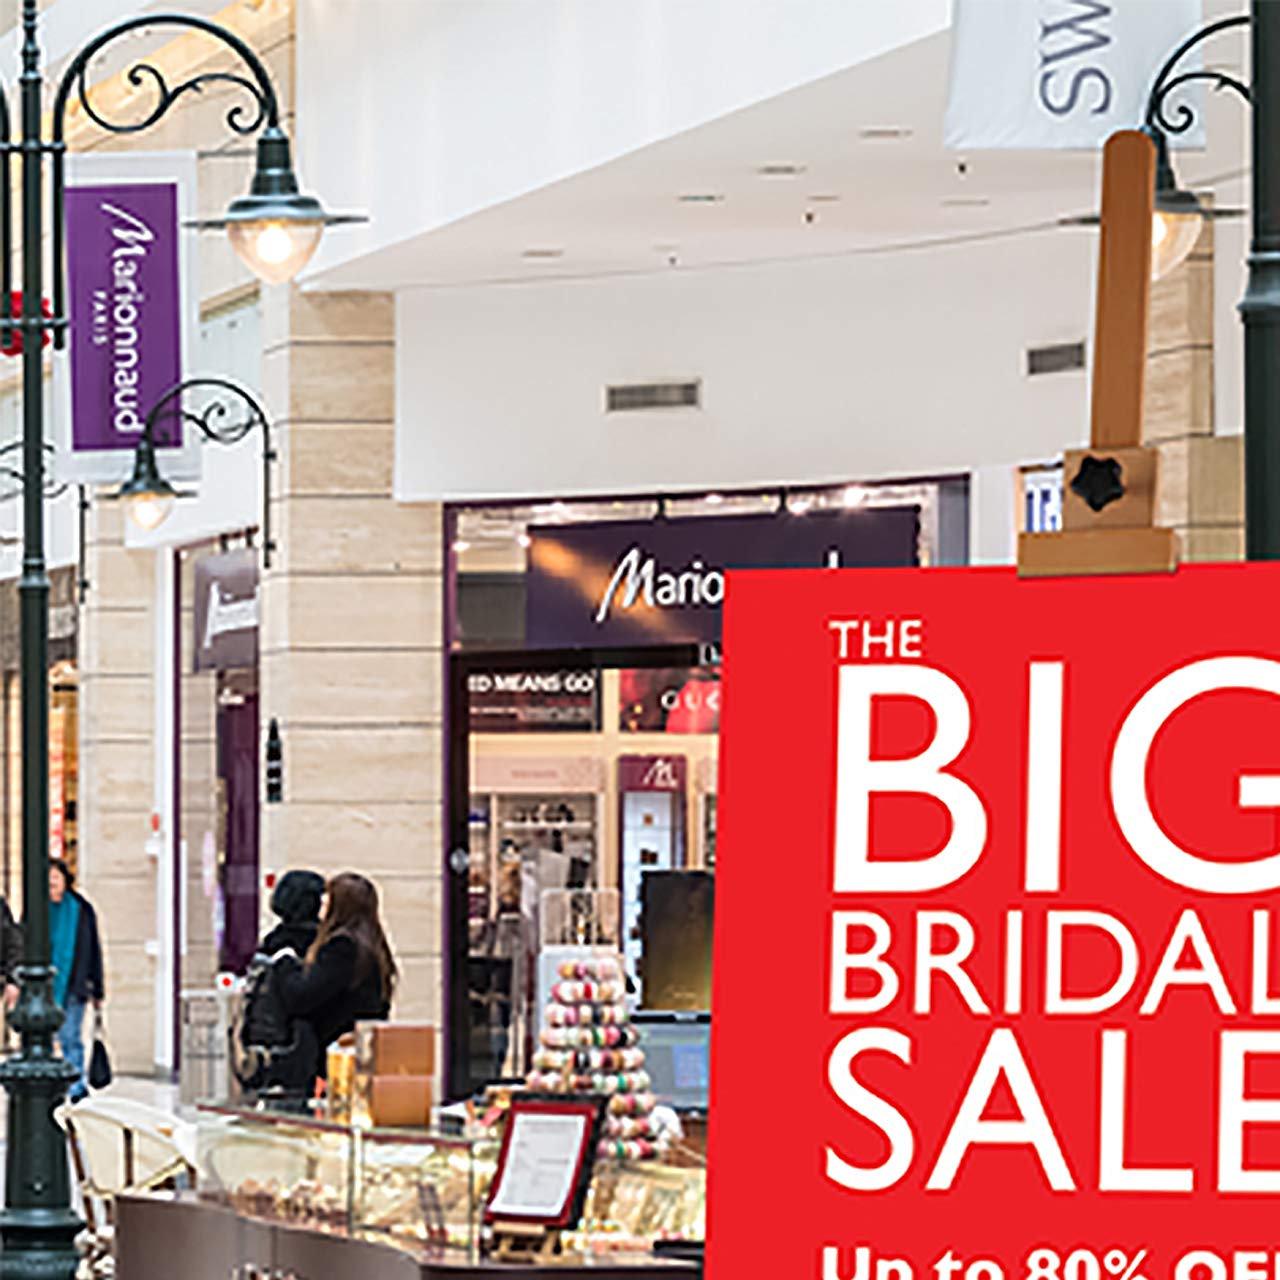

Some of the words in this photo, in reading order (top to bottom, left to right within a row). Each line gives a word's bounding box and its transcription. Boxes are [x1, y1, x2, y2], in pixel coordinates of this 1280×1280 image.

[101, 202, 154, 434] Marionnaud
[828, 620, 922, 658] THE
[468, 675, 491, 692] ED
